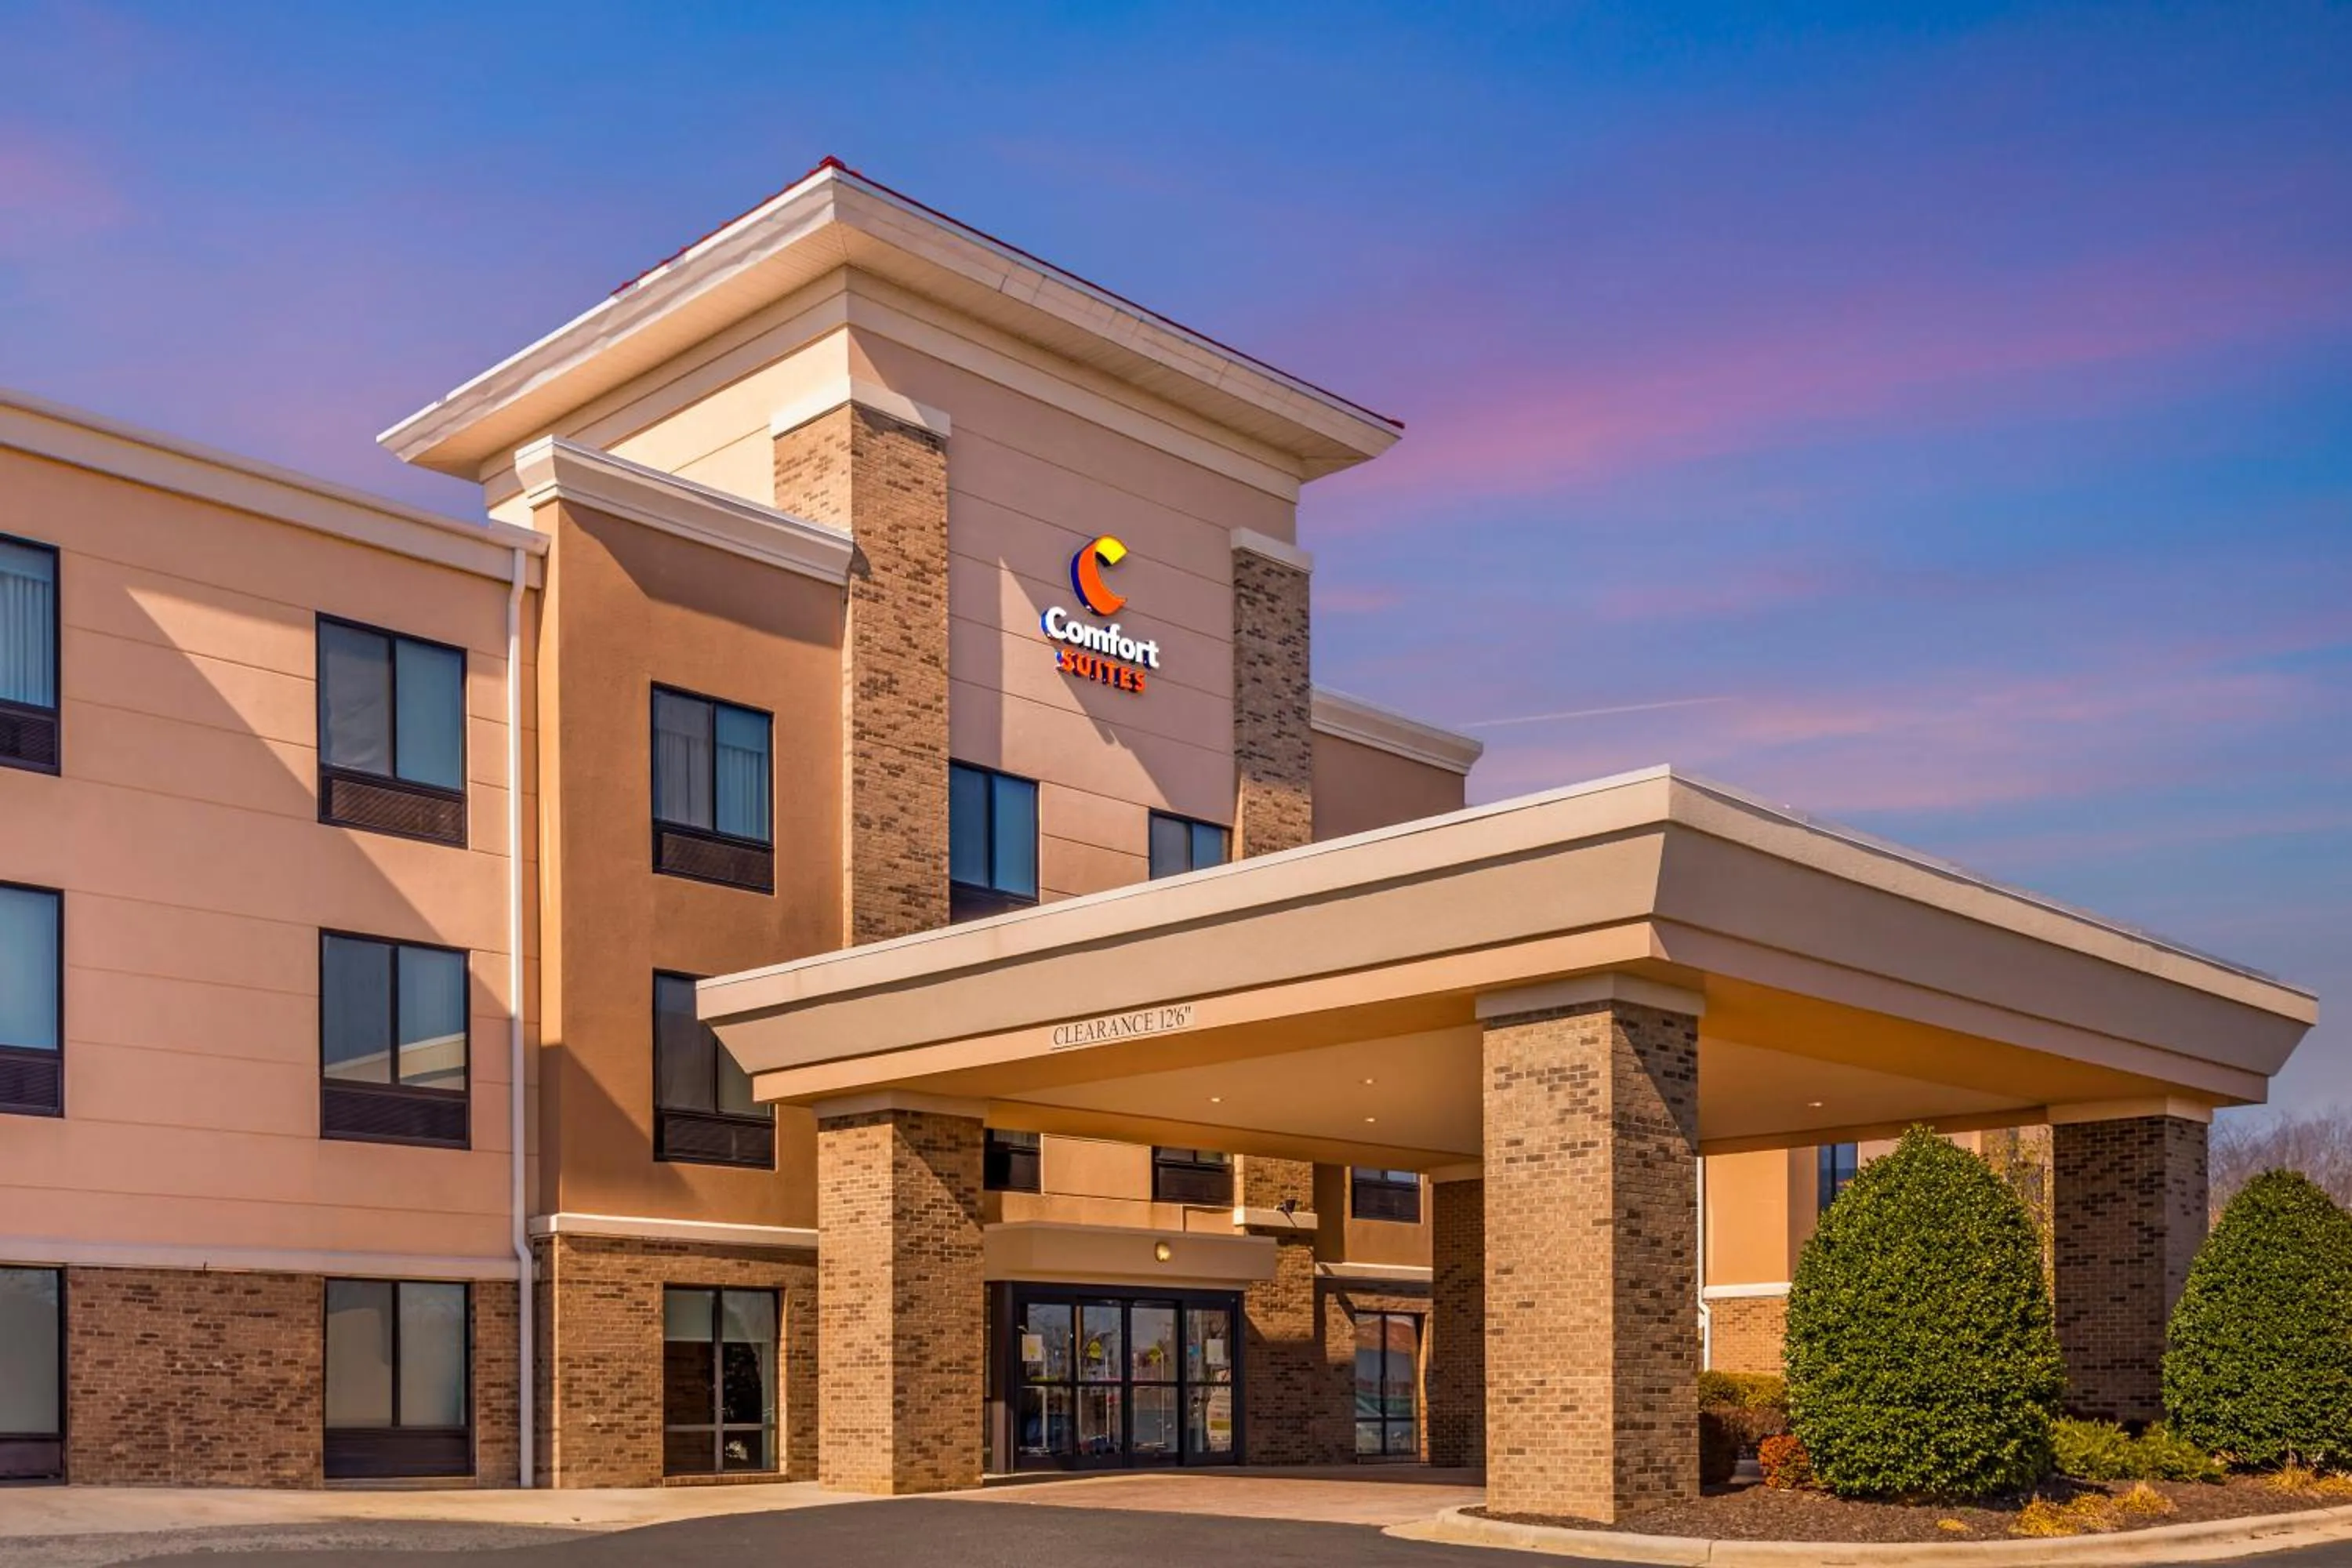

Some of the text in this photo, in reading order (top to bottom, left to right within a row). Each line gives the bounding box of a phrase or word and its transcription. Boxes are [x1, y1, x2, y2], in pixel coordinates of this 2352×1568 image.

[1041, 606, 1160, 669] Comfort
[1057, 646, 1146, 693] SUITES
[1053, 1011, 1154, 1046] CLEARANCE
